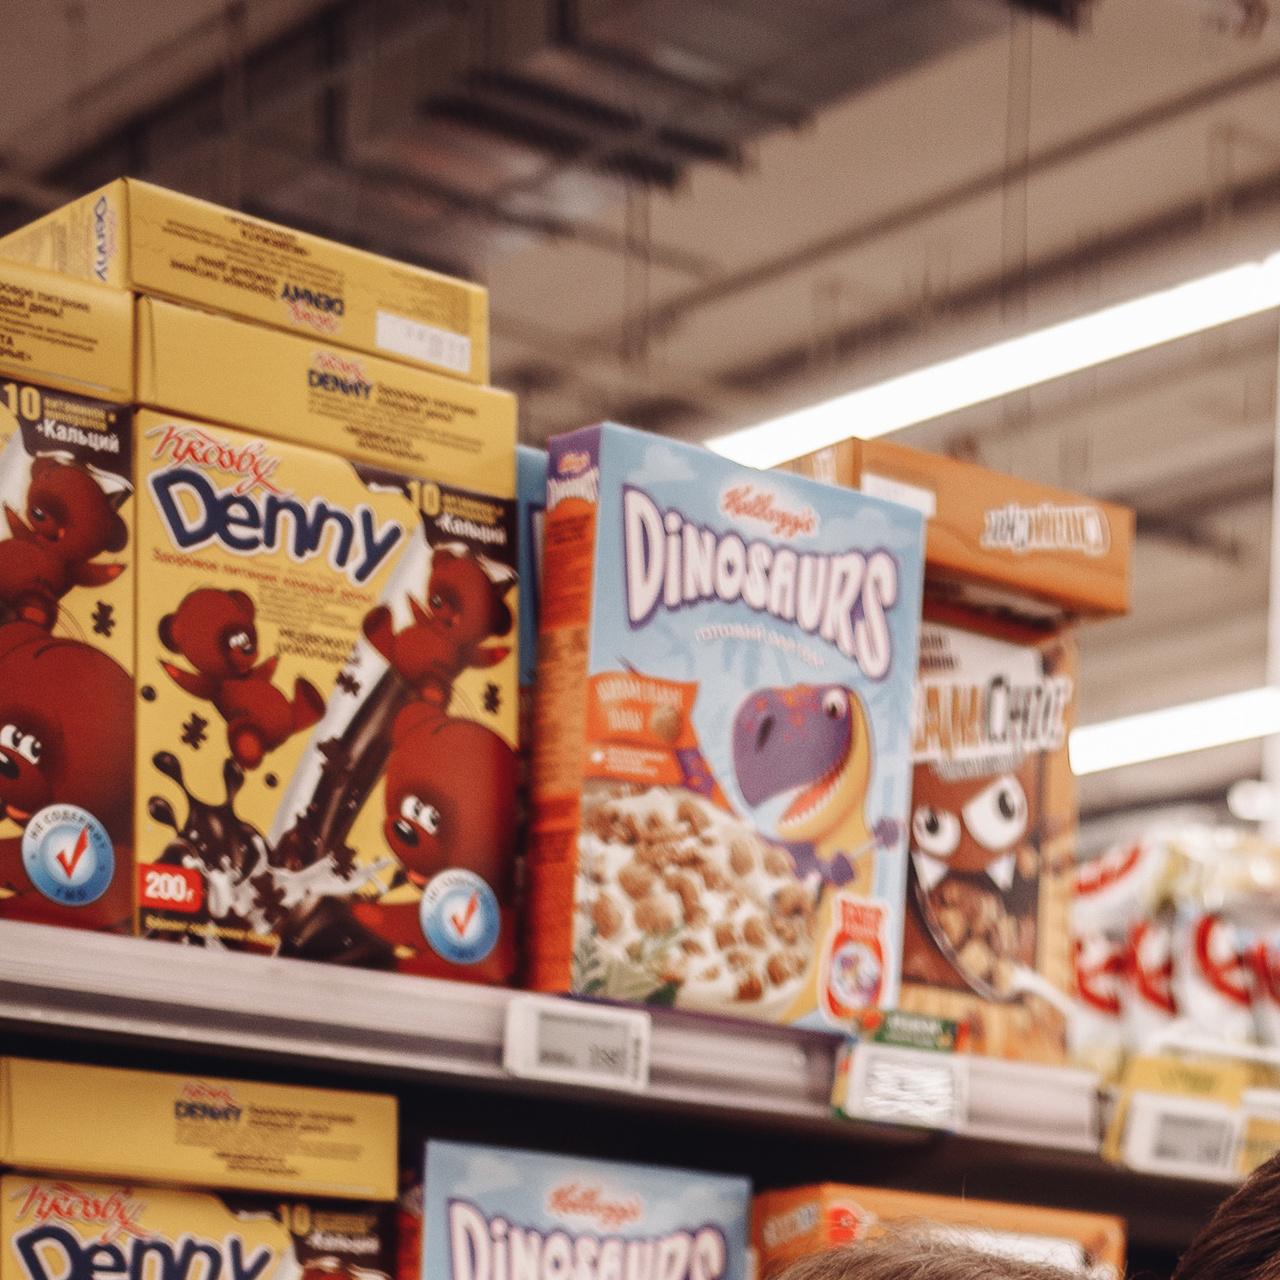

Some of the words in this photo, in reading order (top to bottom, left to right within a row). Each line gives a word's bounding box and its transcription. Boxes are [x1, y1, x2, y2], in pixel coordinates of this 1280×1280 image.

[3, 382, 41, 421] 10
[405, 480, 442, 516] 10
[151, 468, 402, 582] Denny
